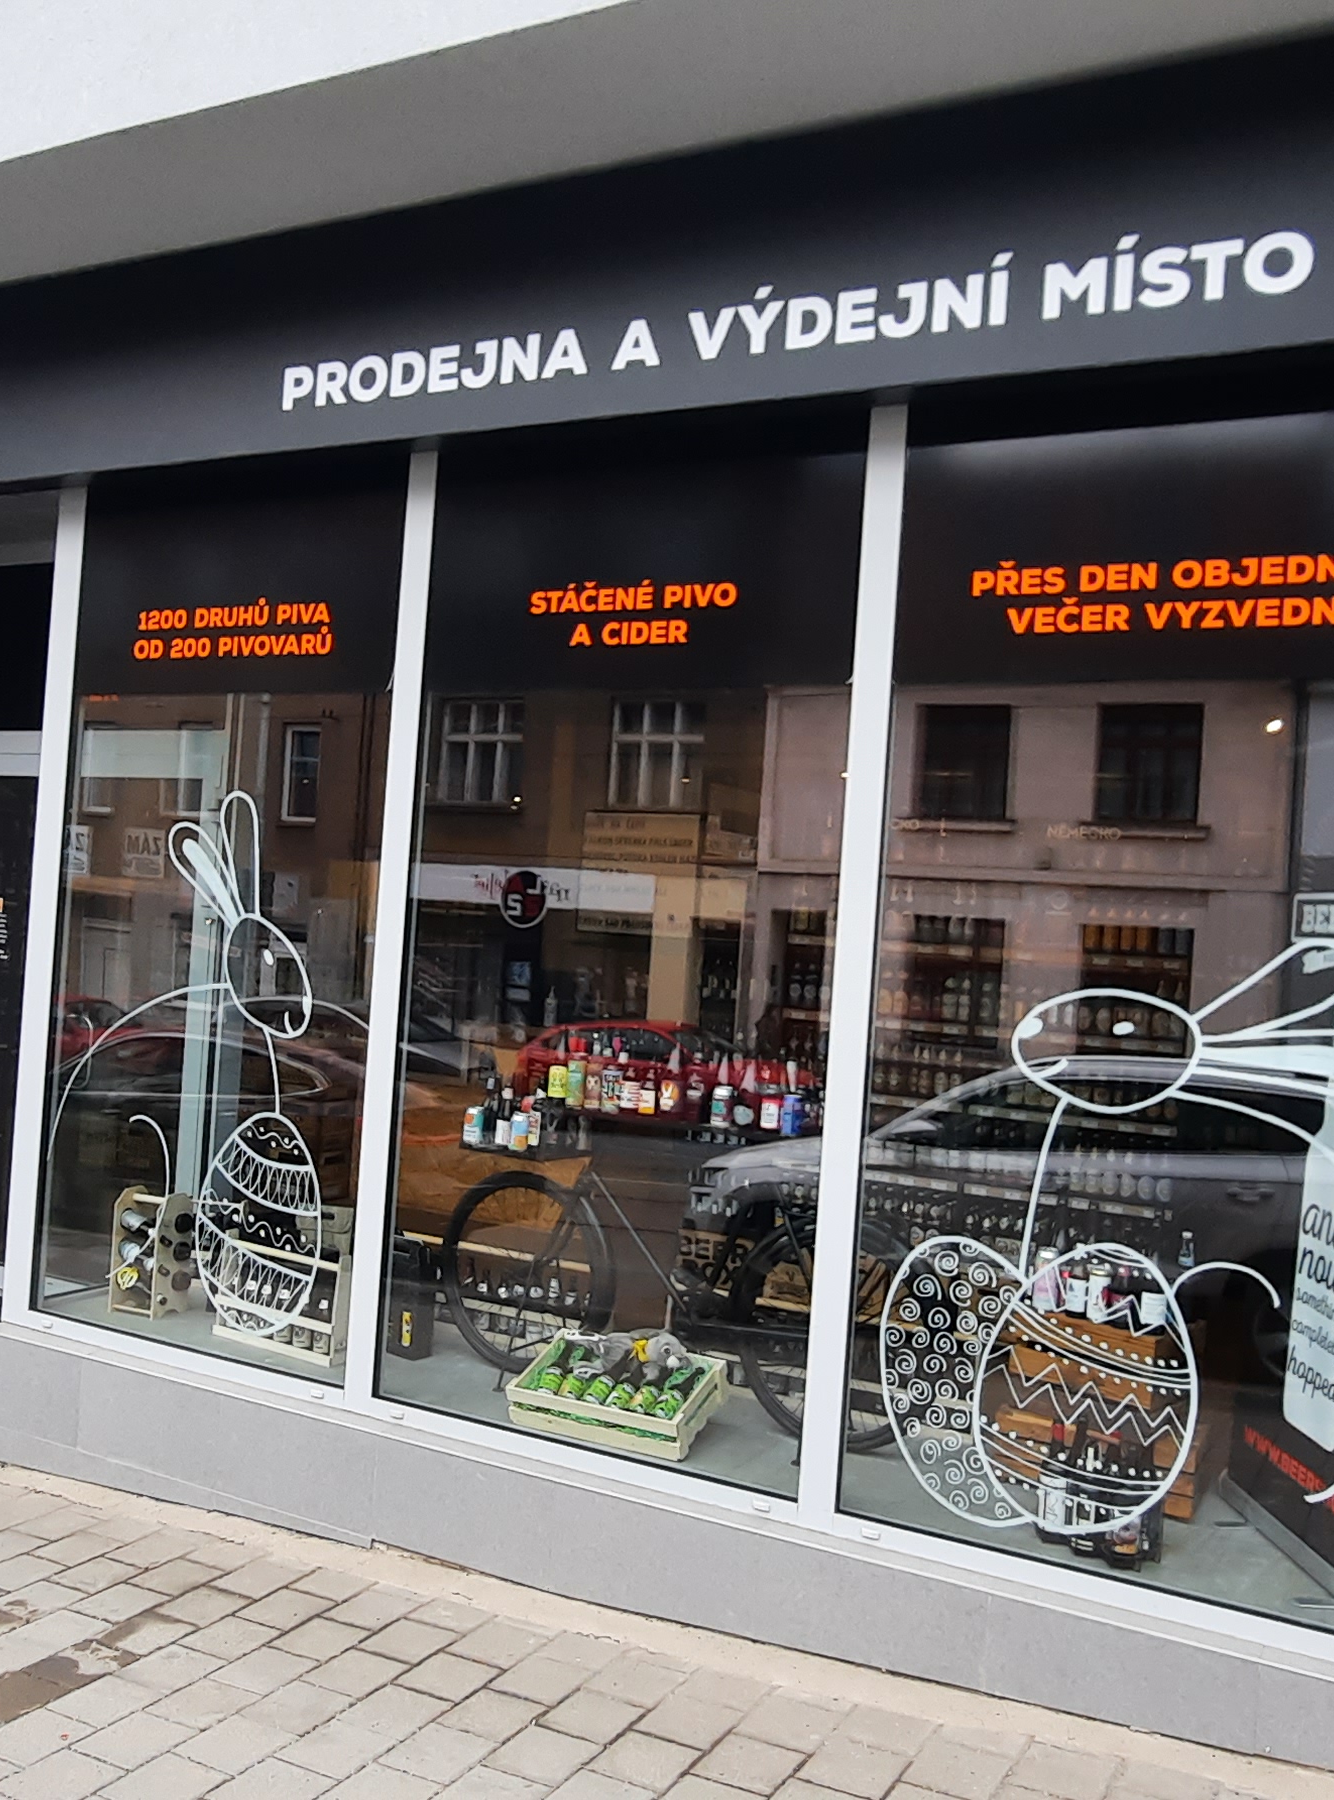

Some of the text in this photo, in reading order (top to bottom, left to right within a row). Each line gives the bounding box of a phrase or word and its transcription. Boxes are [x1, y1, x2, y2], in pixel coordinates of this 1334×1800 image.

[281, 328, 588, 411] PRODEJNA
[610, 318, 661, 371] A
[687, 250, 1015, 361] VÝDEJNÍ
[1041, 231, 1316, 321] MÍSTO
[972, 560, 1066, 597] PŘES
[1079, 562, 1158, 593] DEN
[138, 597, 331, 631] 1200 DRUHŮ PIVA
[530, 579, 737, 615] STÁČENÉ PIVO
[570, 619, 688, 646] A CIDER
[1007, 597, 1130, 634] VEČER
[133, 626, 333, 660] OD 200 PIVOVARŮ
